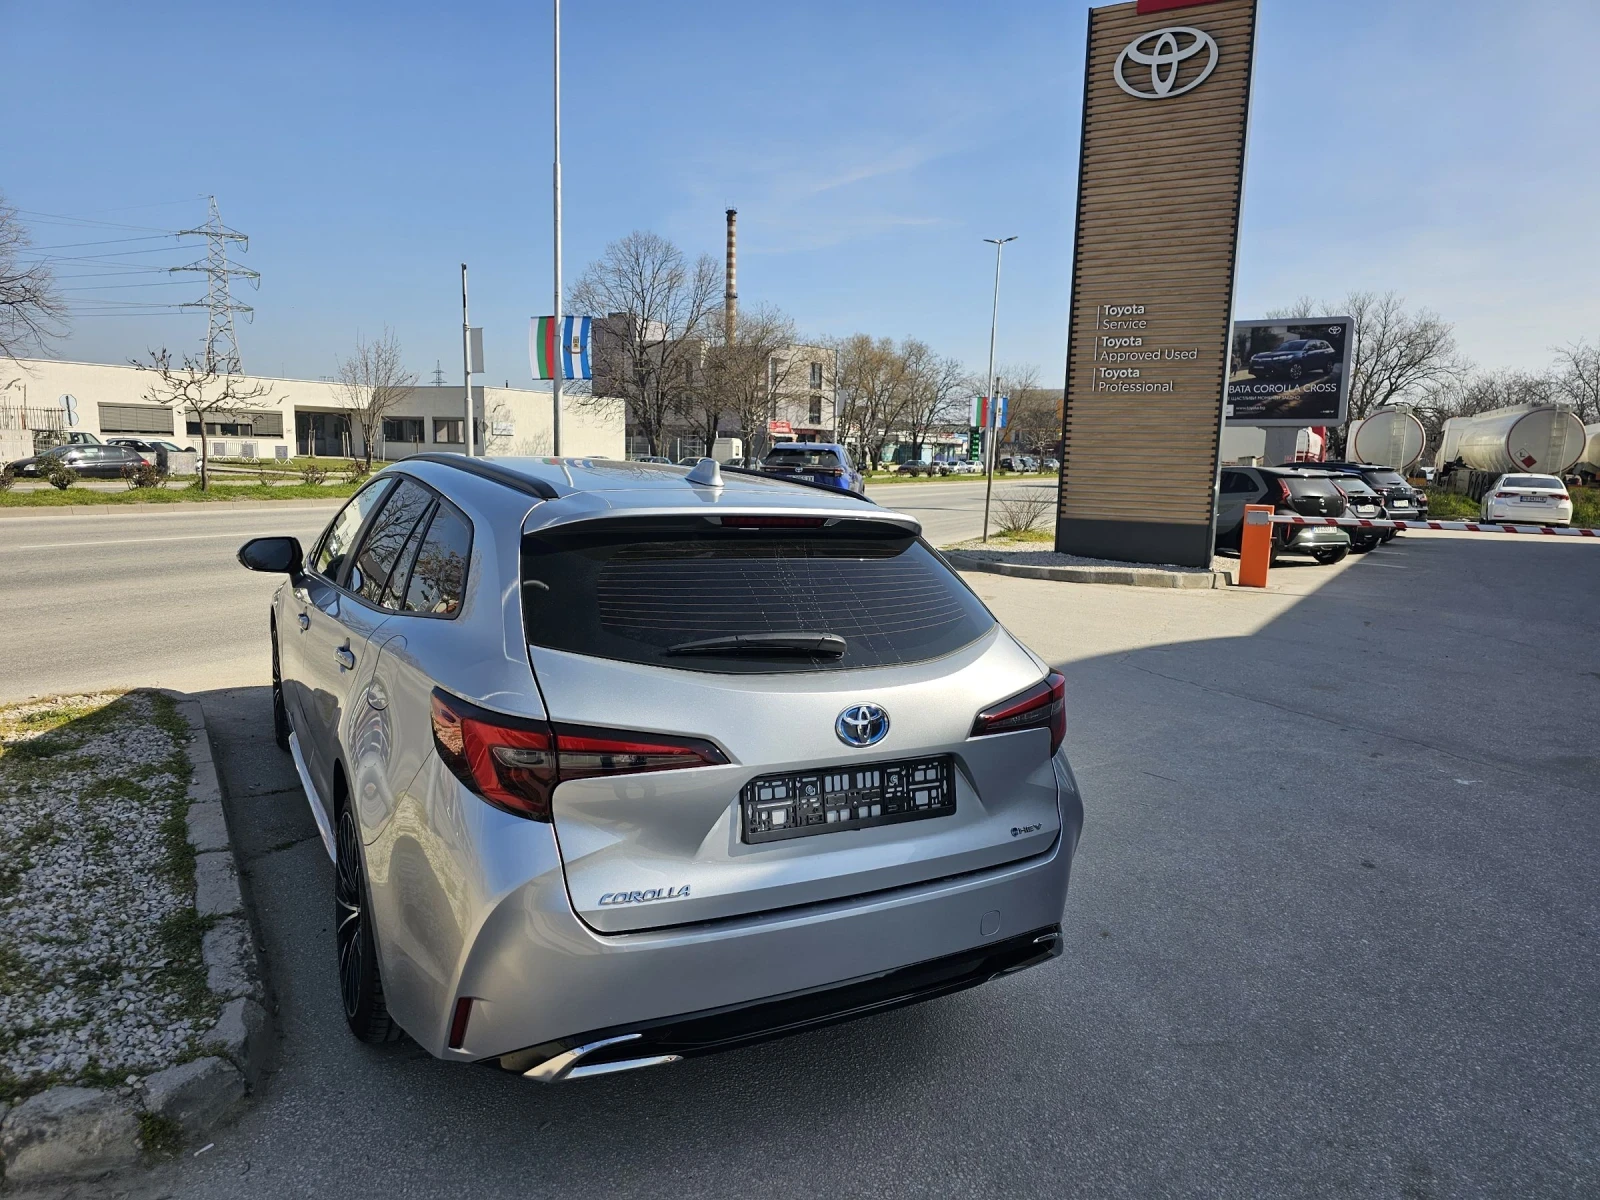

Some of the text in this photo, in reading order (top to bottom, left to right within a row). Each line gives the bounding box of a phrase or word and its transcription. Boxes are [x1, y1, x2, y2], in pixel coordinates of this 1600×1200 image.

[1103, 304, 1145, 317] Toyota
[1102, 318, 1147, 330] Service
[1101, 336, 1142, 349] Toyota
[1100, 347, 1198, 363] Approved Used
[1099, 367, 1140, 380] Toyota
[1098, 380, 1174, 392] Professional
[1253, 384, 1301, 393] COROLLA
[1303, 383, 1337, 393] CROSS
[1018, 822, 1043, 835] HEV
[598, 884, 691, 906] COROLLA
